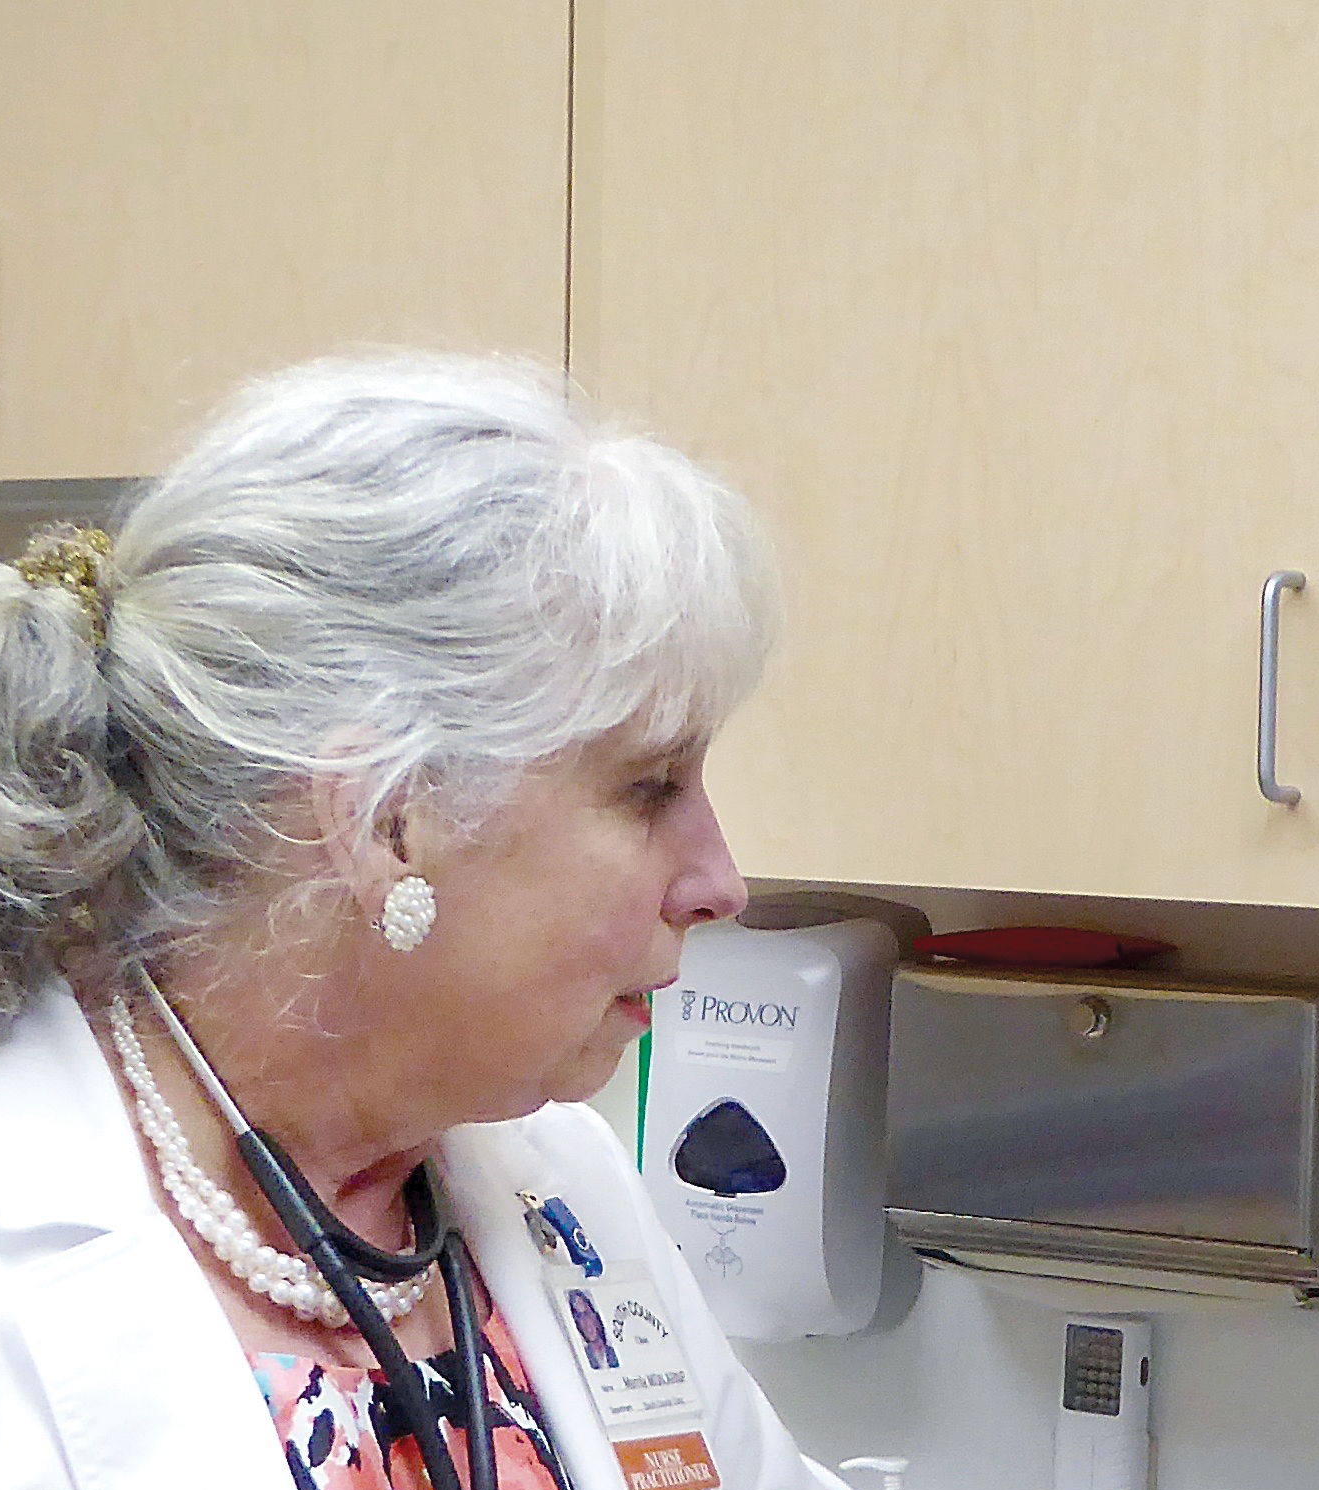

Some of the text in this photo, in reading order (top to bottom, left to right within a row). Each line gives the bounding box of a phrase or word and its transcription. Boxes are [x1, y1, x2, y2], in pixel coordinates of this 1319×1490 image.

[701, 996, 798, 1027] PROVON
[644, 1448, 684, 1468] NURSE
[631, 1463, 712, 1490] PRACTITIONER
